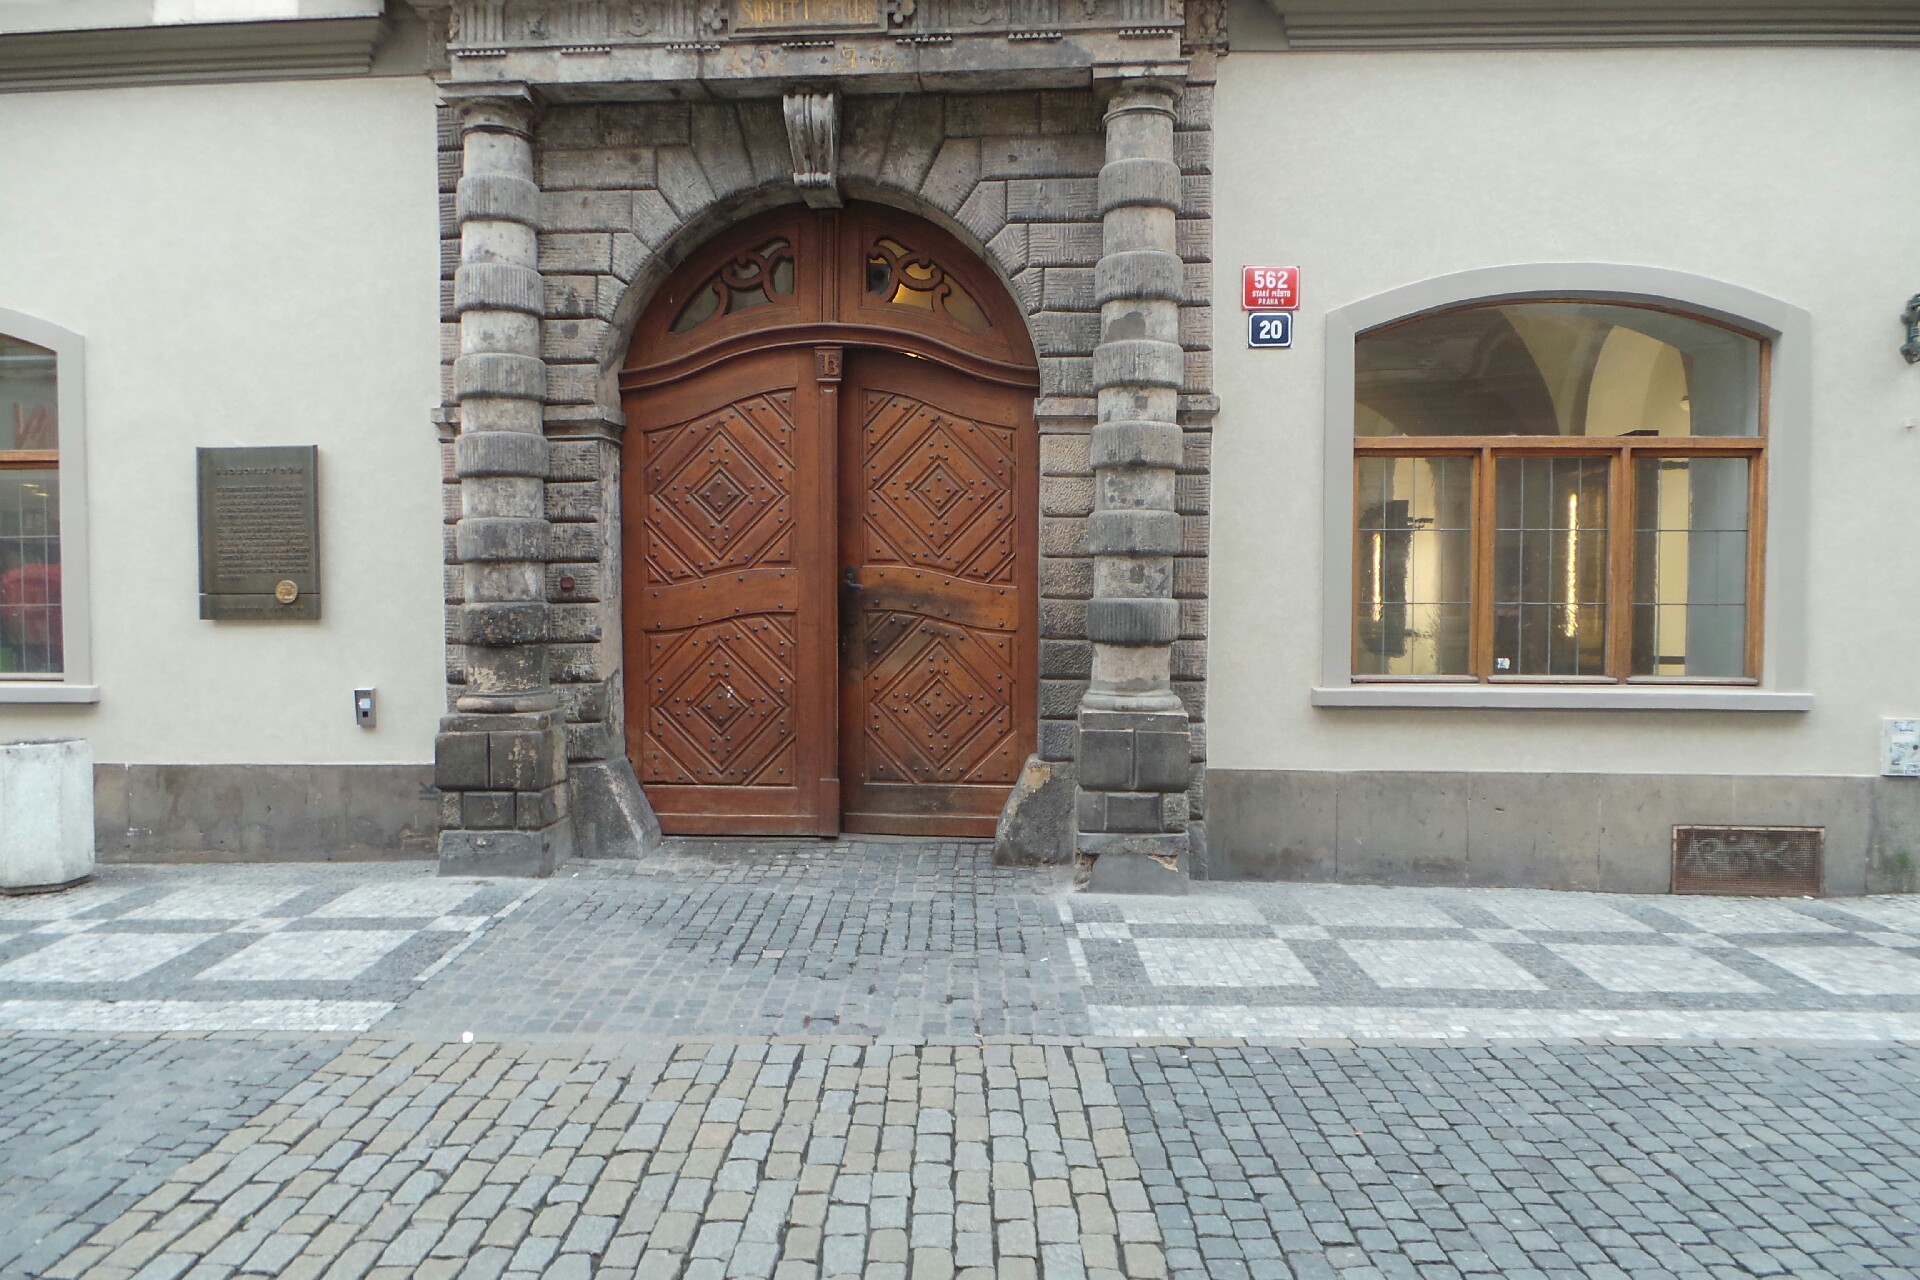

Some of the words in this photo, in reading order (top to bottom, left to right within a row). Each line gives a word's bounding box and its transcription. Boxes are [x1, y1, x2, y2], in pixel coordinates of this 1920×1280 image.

[1254, 271, 1289, 289] 562
[1252, 289, 1270, 298] STARÉ
[1271, 289, 1291, 298] MĚSTO
[1259, 320, 1282, 339] 20
